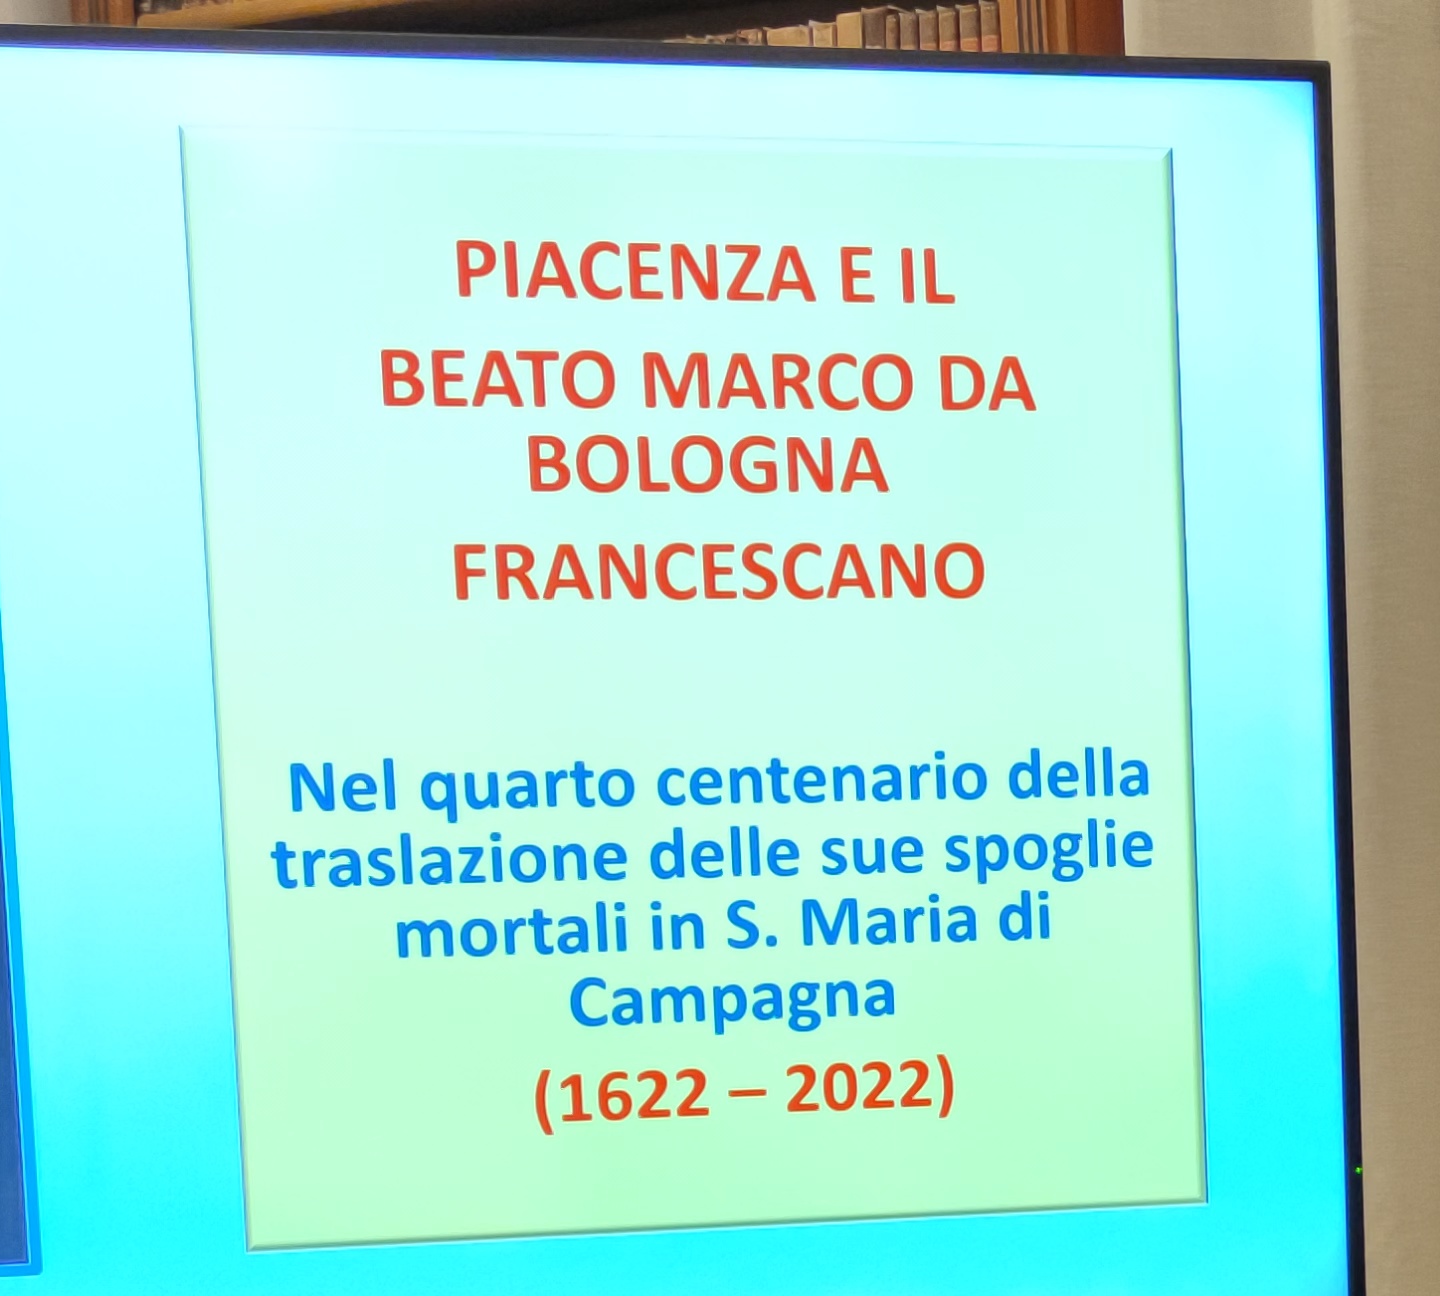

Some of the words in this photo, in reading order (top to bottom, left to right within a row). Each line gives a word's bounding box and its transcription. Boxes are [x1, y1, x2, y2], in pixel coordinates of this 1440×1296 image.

[455, 239, 817, 304] PIACENZA
[839, 245, 876, 304] E
[900, 247, 957, 305] IL
[379, 348, 617, 411] BEATO
[642, 351, 915, 413] MARCO
[939, 354, 1038, 413] DA
[526, 433, 890, 496] BOLOGNA
[453, 541, 987, 603] FRANCESCANO
[287, 758, 398, 815] Nel
[418, 761, 637, 825] quarto
[655, 749, 990, 809] centenario
[1006, 745, 1151, 801] della
[268, 830, 629, 892] traslazione
[648, 824, 802, 882] delle
[820, 834, 926, 878] sue
[943, 815, 1156, 886] spoglie
[395, 899, 630, 960] mortali
[649, 899, 707, 952] in
[725, 898, 780, 952] S.
[800, 892, 979, 949] Maria
[997, 888, 1052, 944] di
[567, 975, 897, 1037] Campagna
[534, 1067, 711, 1136] (1622
[786, 1053, 956, 1120] 2022)
